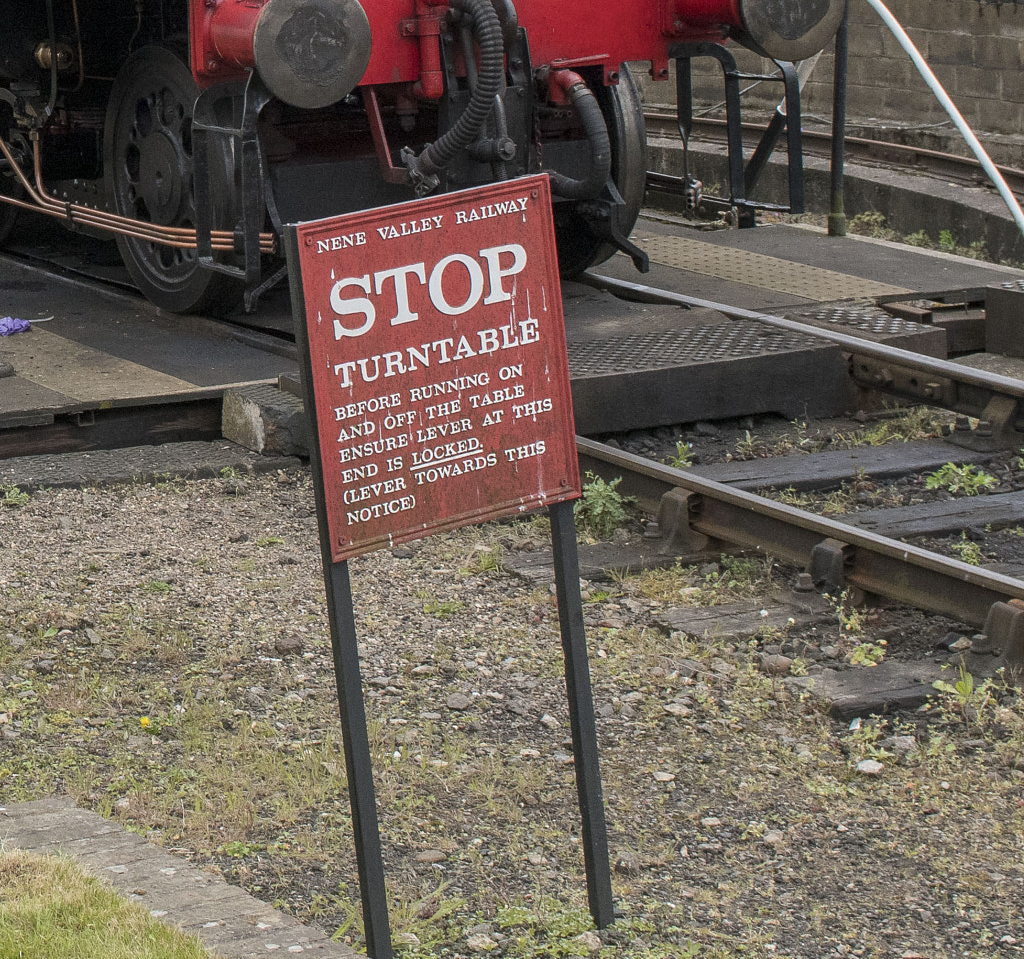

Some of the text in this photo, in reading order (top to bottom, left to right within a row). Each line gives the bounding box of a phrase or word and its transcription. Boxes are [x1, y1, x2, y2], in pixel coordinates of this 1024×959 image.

[317, 197, 529, 253] NENE VALLEY RAILWAY
[329, 243, 528, 341] STOP
[334, 318, 540, 389] TURNTABLE
[334, 364, 523, 421] BEFORE RUNNING ON
[337, 385, 525, 442] AND OFF THE TABLE
[339, 398, 553, 463] ENSURE LEVER AT THIS
[342, 438, 484, 484] END IS LOCKED.
[343, 441, 546, 505] (LEVER TOWARDS THIS
[347, 495, 417, 525] NOTICE)
